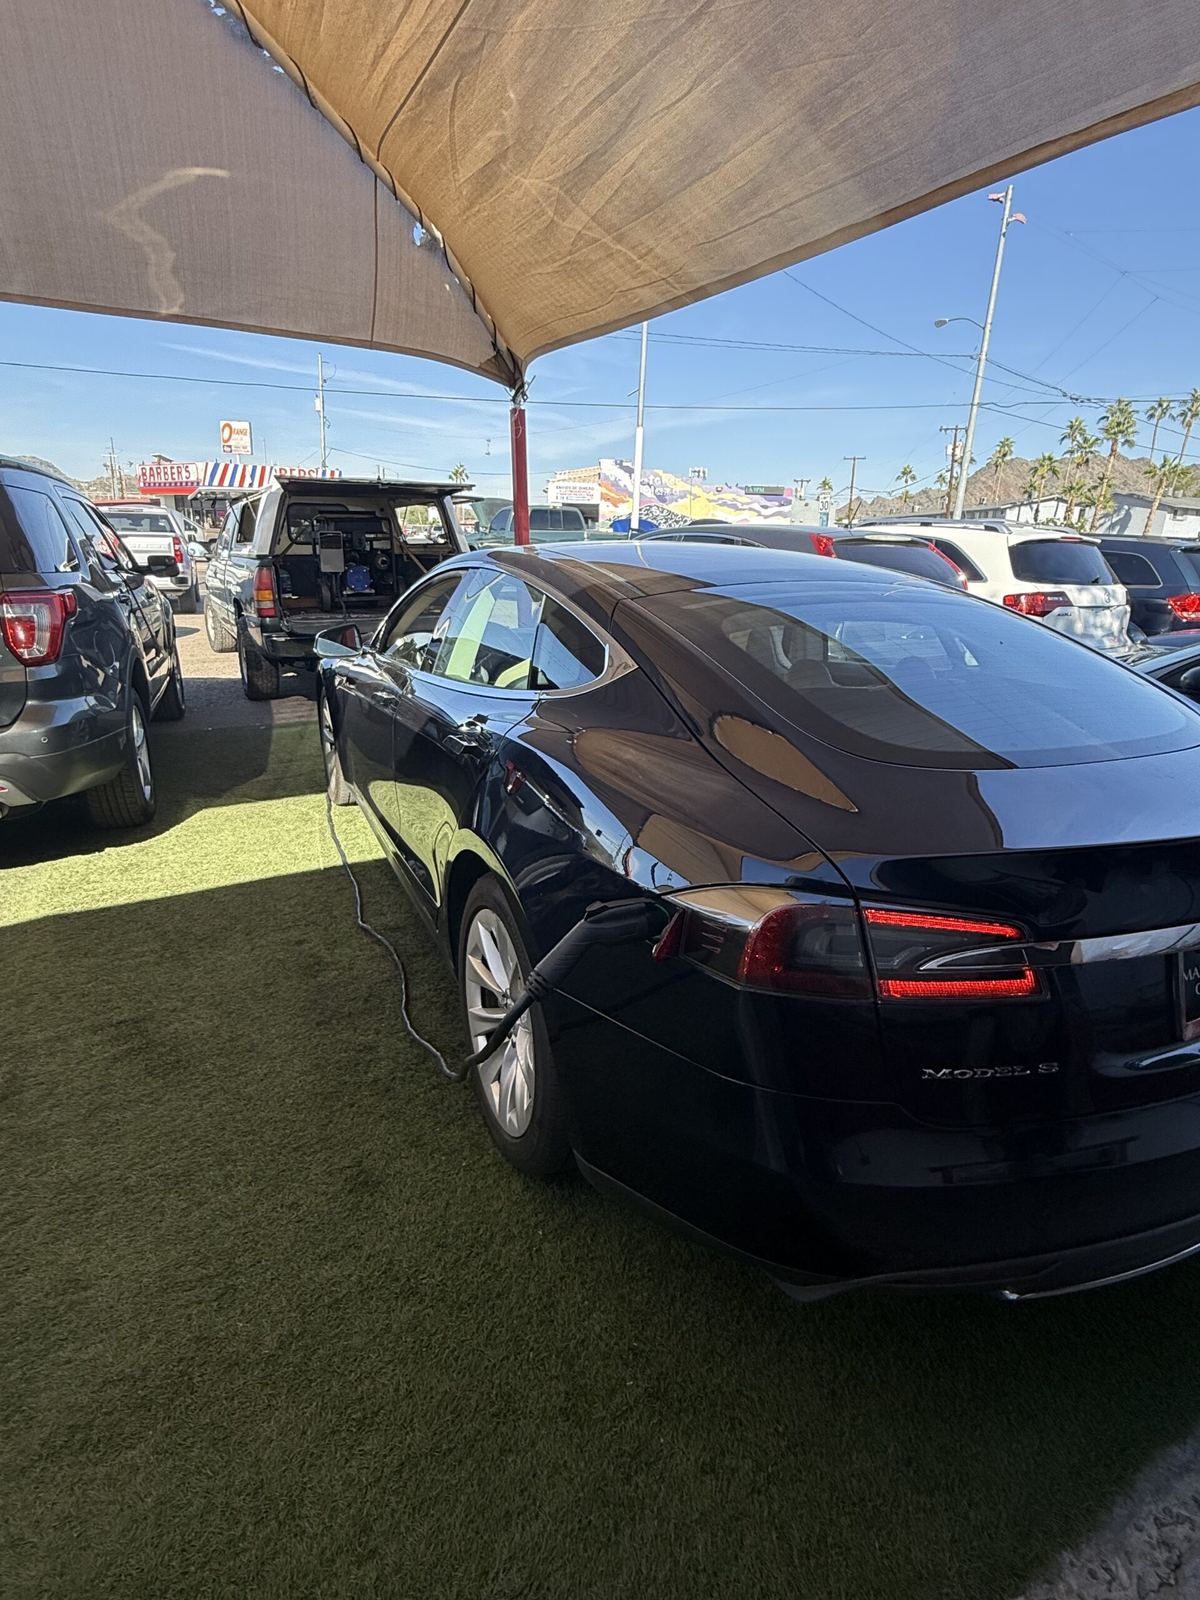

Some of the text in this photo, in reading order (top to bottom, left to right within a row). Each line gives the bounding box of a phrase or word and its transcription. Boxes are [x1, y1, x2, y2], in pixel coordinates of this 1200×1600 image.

[140, 464, 191, 482] BARBER'S
[819, 500, 829, 512] 30
[921, 1062, 1059, 1079] MODEL S
